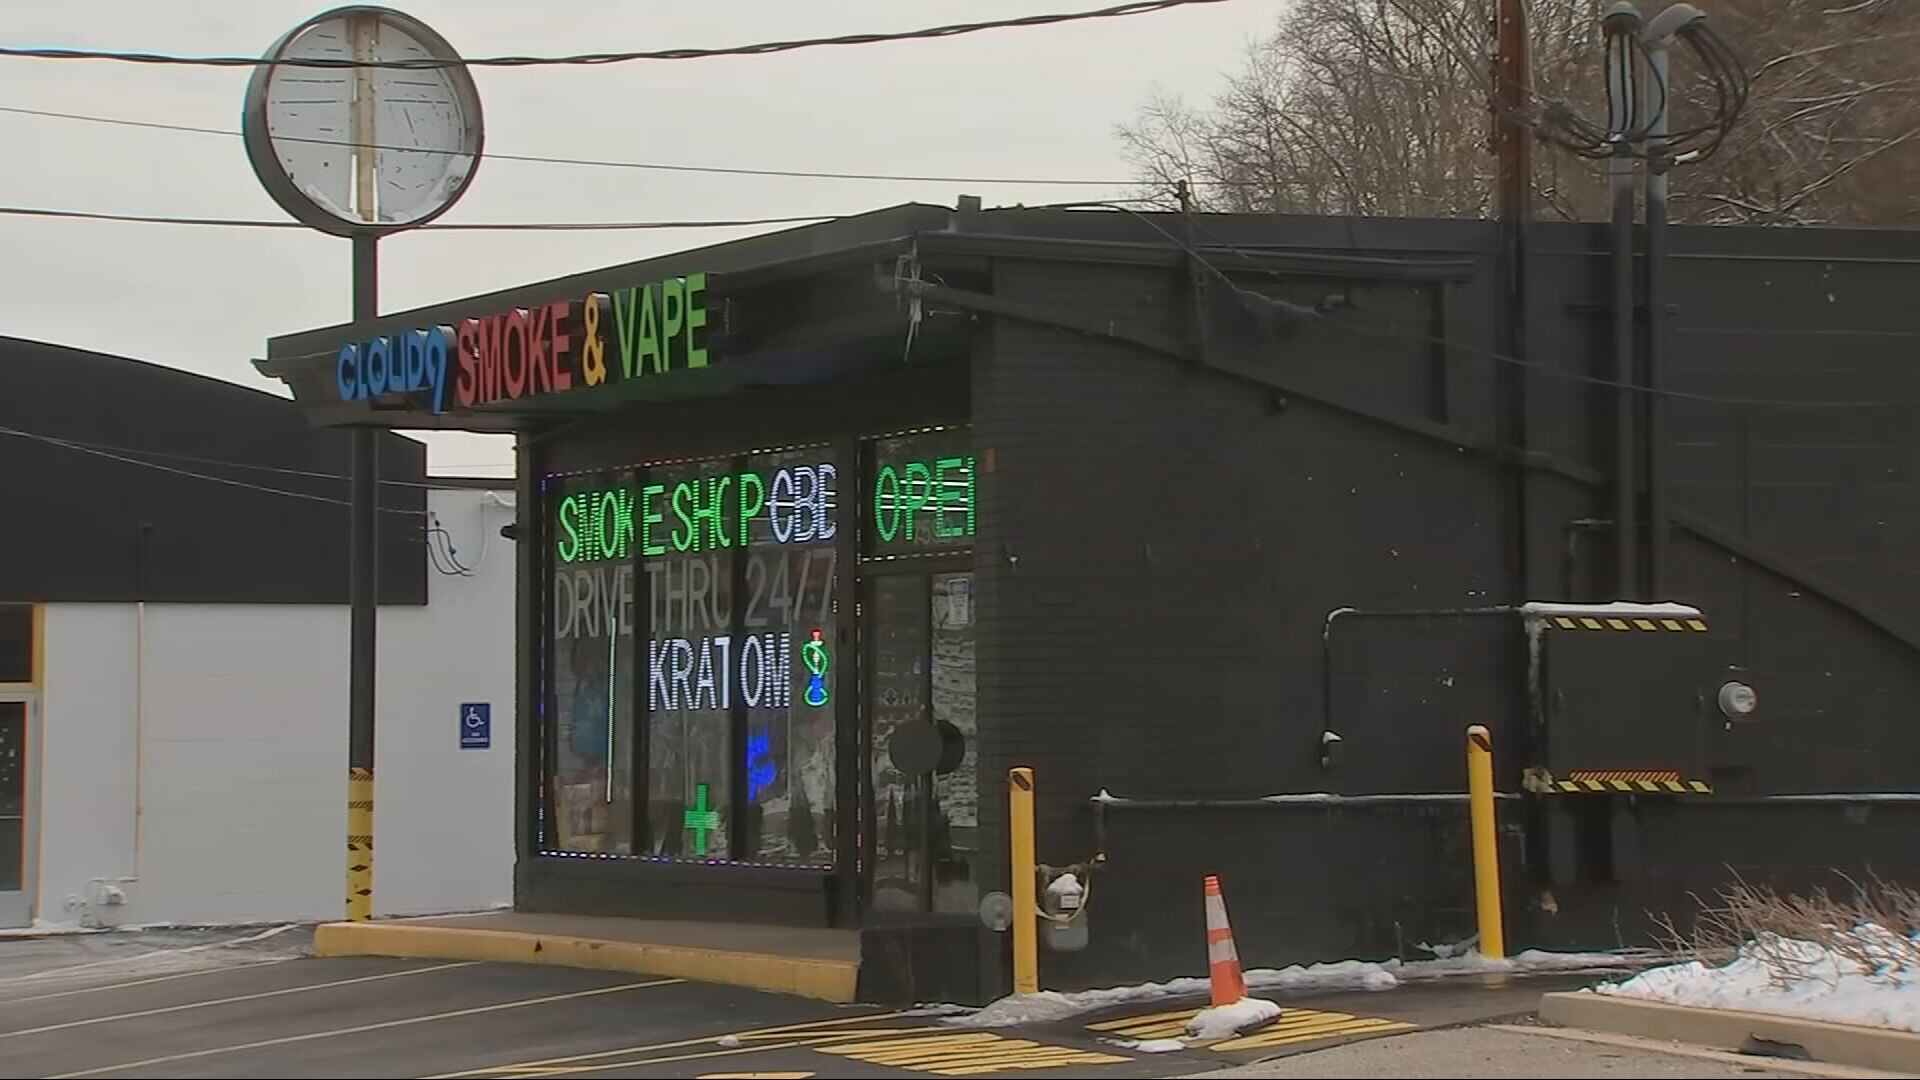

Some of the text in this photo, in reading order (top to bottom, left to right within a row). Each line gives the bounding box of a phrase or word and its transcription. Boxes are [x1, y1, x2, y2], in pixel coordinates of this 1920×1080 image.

[336, 272, 709, 415] CLOUD9 SMOKE & VAPE
[558, 485, 666, 562] SMOKE
[554, 564, 635, 640] DRIVE
[744, 548, 836, 628] 24/7
[650, 633, 790, 711] KRATOM
